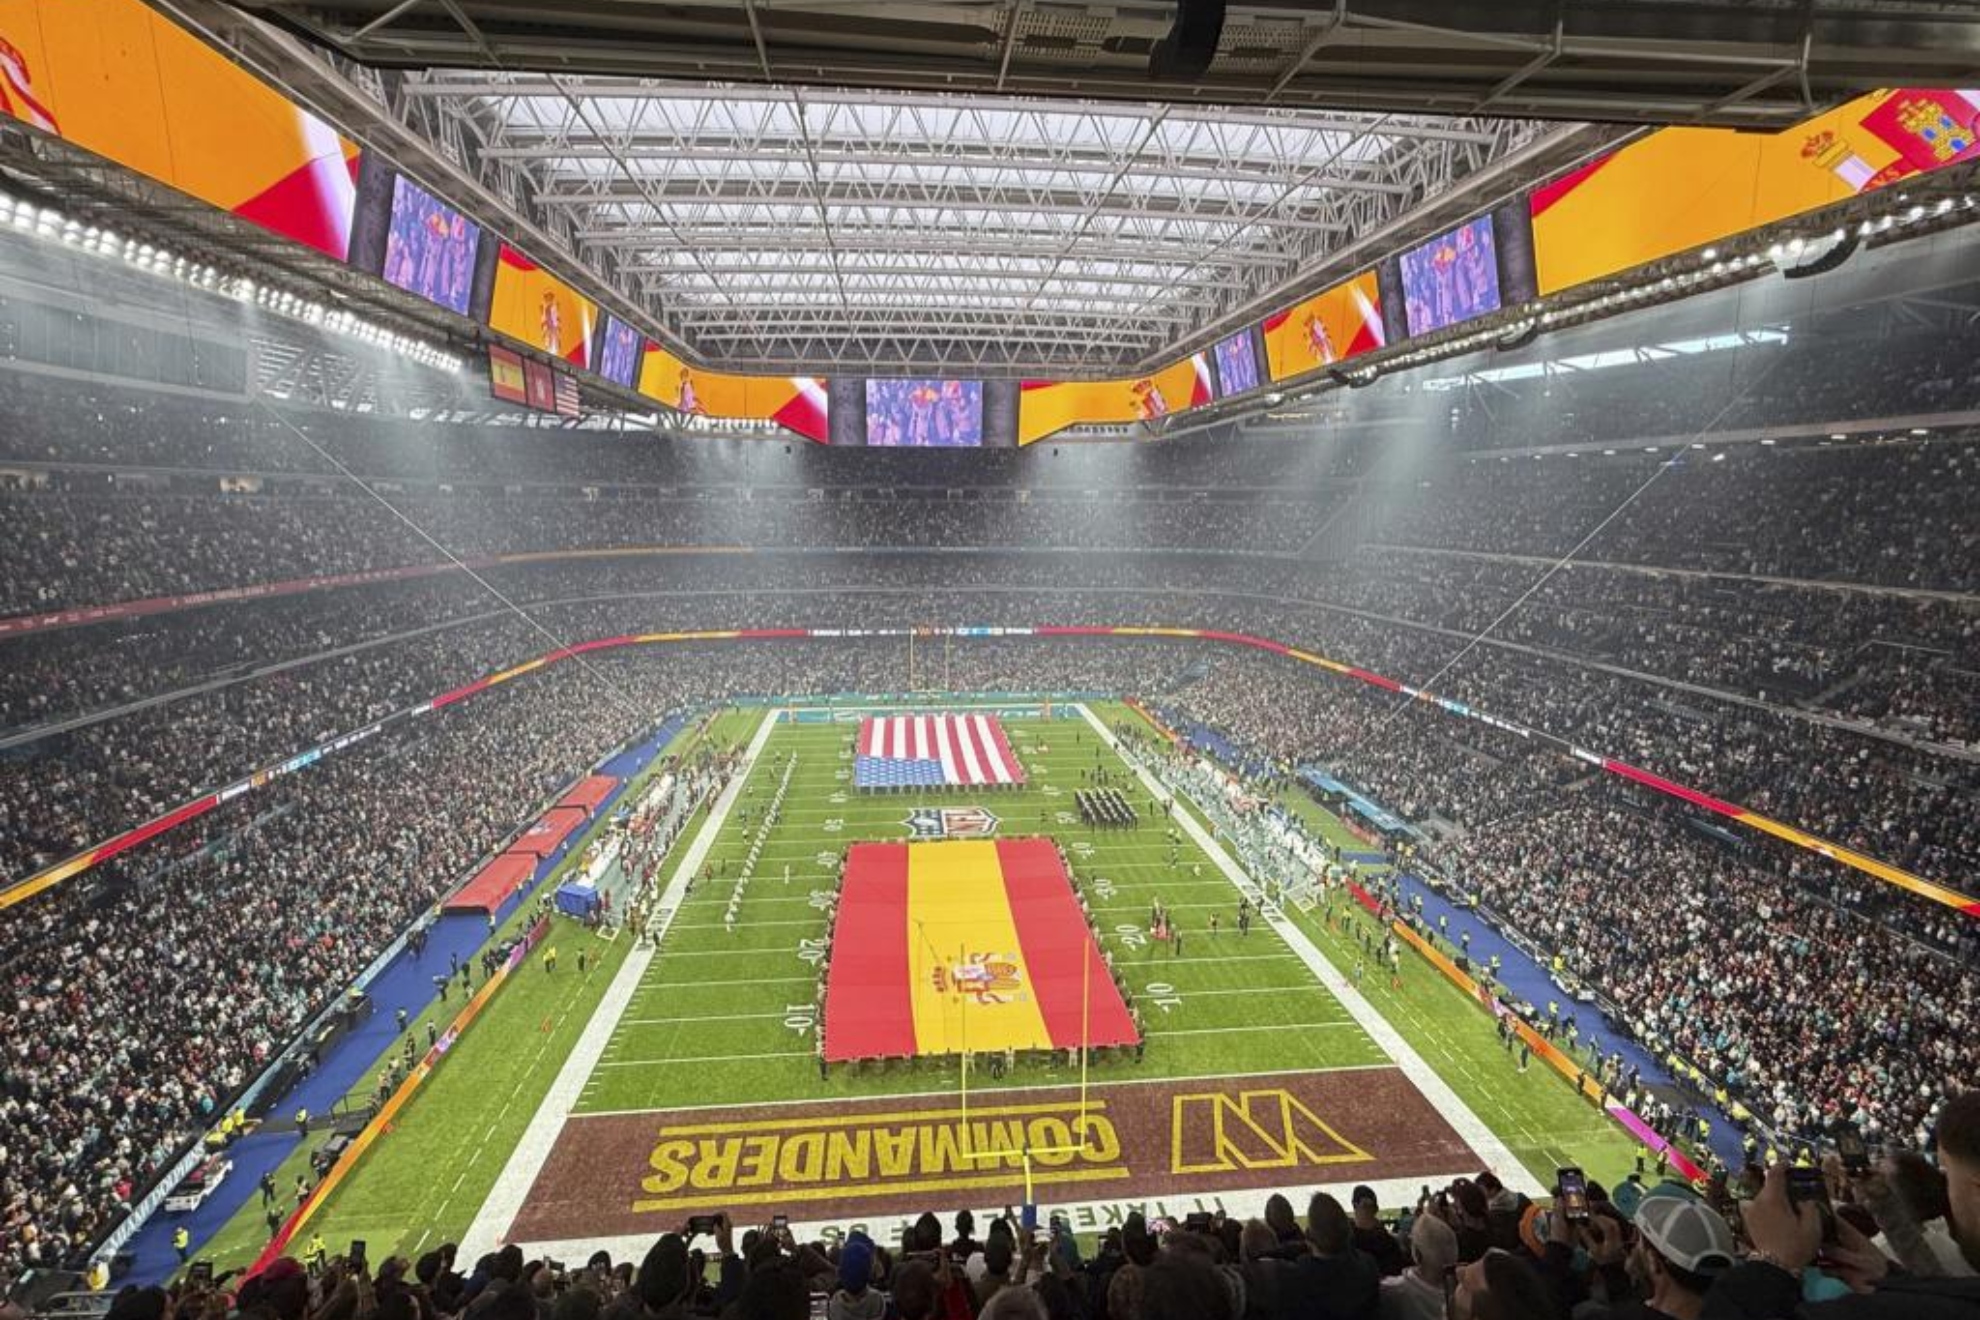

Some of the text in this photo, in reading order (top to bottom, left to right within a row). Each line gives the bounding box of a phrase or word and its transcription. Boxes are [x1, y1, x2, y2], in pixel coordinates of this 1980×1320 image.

[1115, 924, 1147, 945] 20
[1145, 982, 1183, 1007] 10
[784, 1003, 816, 1029] 10
[641, 1113, 1121, 1193] COMMANDERS
